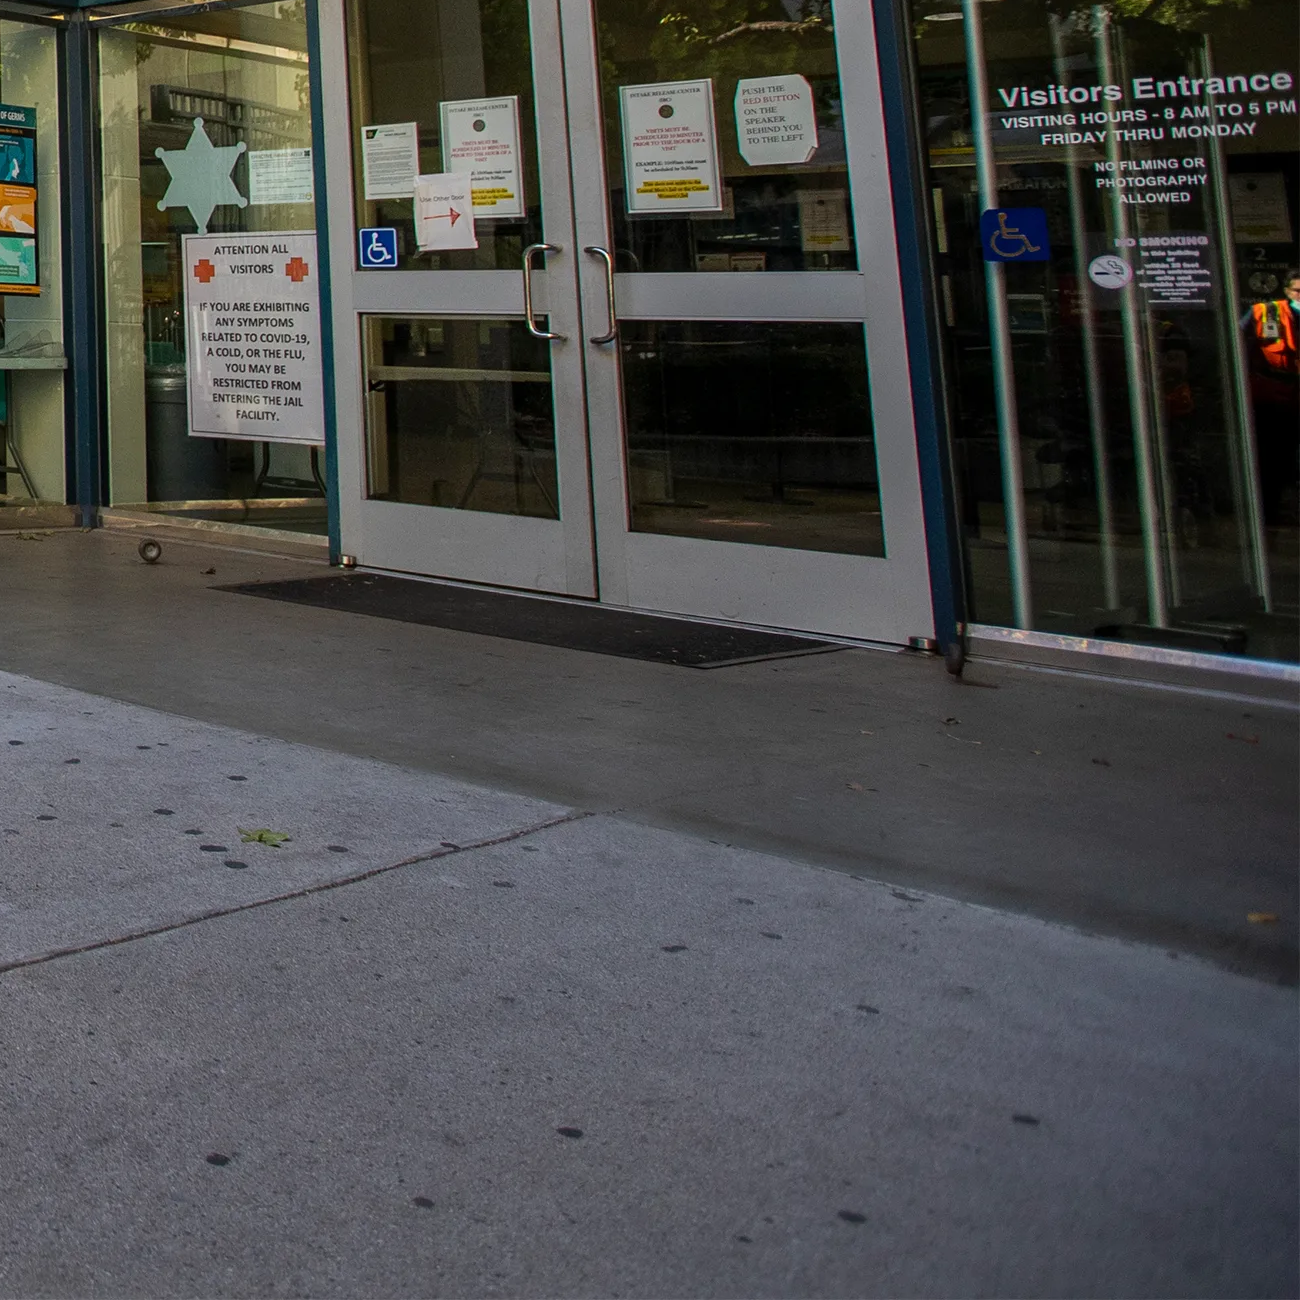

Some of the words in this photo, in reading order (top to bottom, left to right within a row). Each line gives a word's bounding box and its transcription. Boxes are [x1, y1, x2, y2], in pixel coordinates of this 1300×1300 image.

[742, 87, 765, 96] PUSH
[998, 83, 1122, 108] Visitors
[1132, 72, 1292, 99] Entrance
[763, 93, 800, 103] BUTTON
[8, 113, 25, 121] GERMS
[1001, 113, 1076, 129] VISITING
[1081, 109, 1147, 124] HOURS
[1164, 107, 1172, 120] 8
[1179, 104, 1211, 119] AM
[1215, 103, 1243, 117] TO
[1249, 102, 1259, 114] 5
[1266, 99, 1296, 114] PM
[745, 116, 786, 125] SPEAKER
[746, 126, 780, 134] BEHIND
[783, 124, 803, 132] YOU
[1041, 129, 1108, 146] FRIDAY
[1114, 126, 1164, 141] THRU
[1171, 122, 1257, 139] MONDAY
[781, 134, 804, 142] LEFT
[1094, 161, 1116, 172] NO
[1119, 158, 1178, 171] FILMING
[1182, 157, 1205, 169] OR
[1096, 174, 1208, 188] PHOTOGRAPHY
[1118, 191, 1191, 204] ALLOWED
[1114, 238, 1137, 247] NO
[1139, 236, 1208, 246] SMOKING
[214, 245, 268, 255] ATTENTION
[272, 244, 288, 253] ALL
[230, 265, 273, 274] VISITORS
[200, 303, 207, 311] IF
[210, 303, 230, 311] YOU
[233, 303, 250, 311] ARE
[254, 302, 309, 312] EXHIBITING
[215, 318, 235, 327] ANY
[237, 318, 294, 327] SYMPTOMS
[201, 332, 241, 342] RELATED
[244, 333, 257, 342] TO
[260, 334, 310, 345] COVID-19,
[207, 348, 214, 356] A
[216, 348, 244, 359] COLD,
[246, 349, 260, 358] OR
[263, 349, 281, 358] THE
[284, 350, 305, 360] FLU,
[225, 364, 245, 373] YOU
[248, 364, 271, 373] MAY
[274, 365, 286, 374] BE
[213, 378, 268, 389] RESTRICTED
[271, 380, 301, 390] FROM
[212, 393, 260, 404] ENTERING
[263, 396, 281, 405] THE
[284, 397, 303, 407] JAIL
[236, 410, 279, 421] FACILITY.
